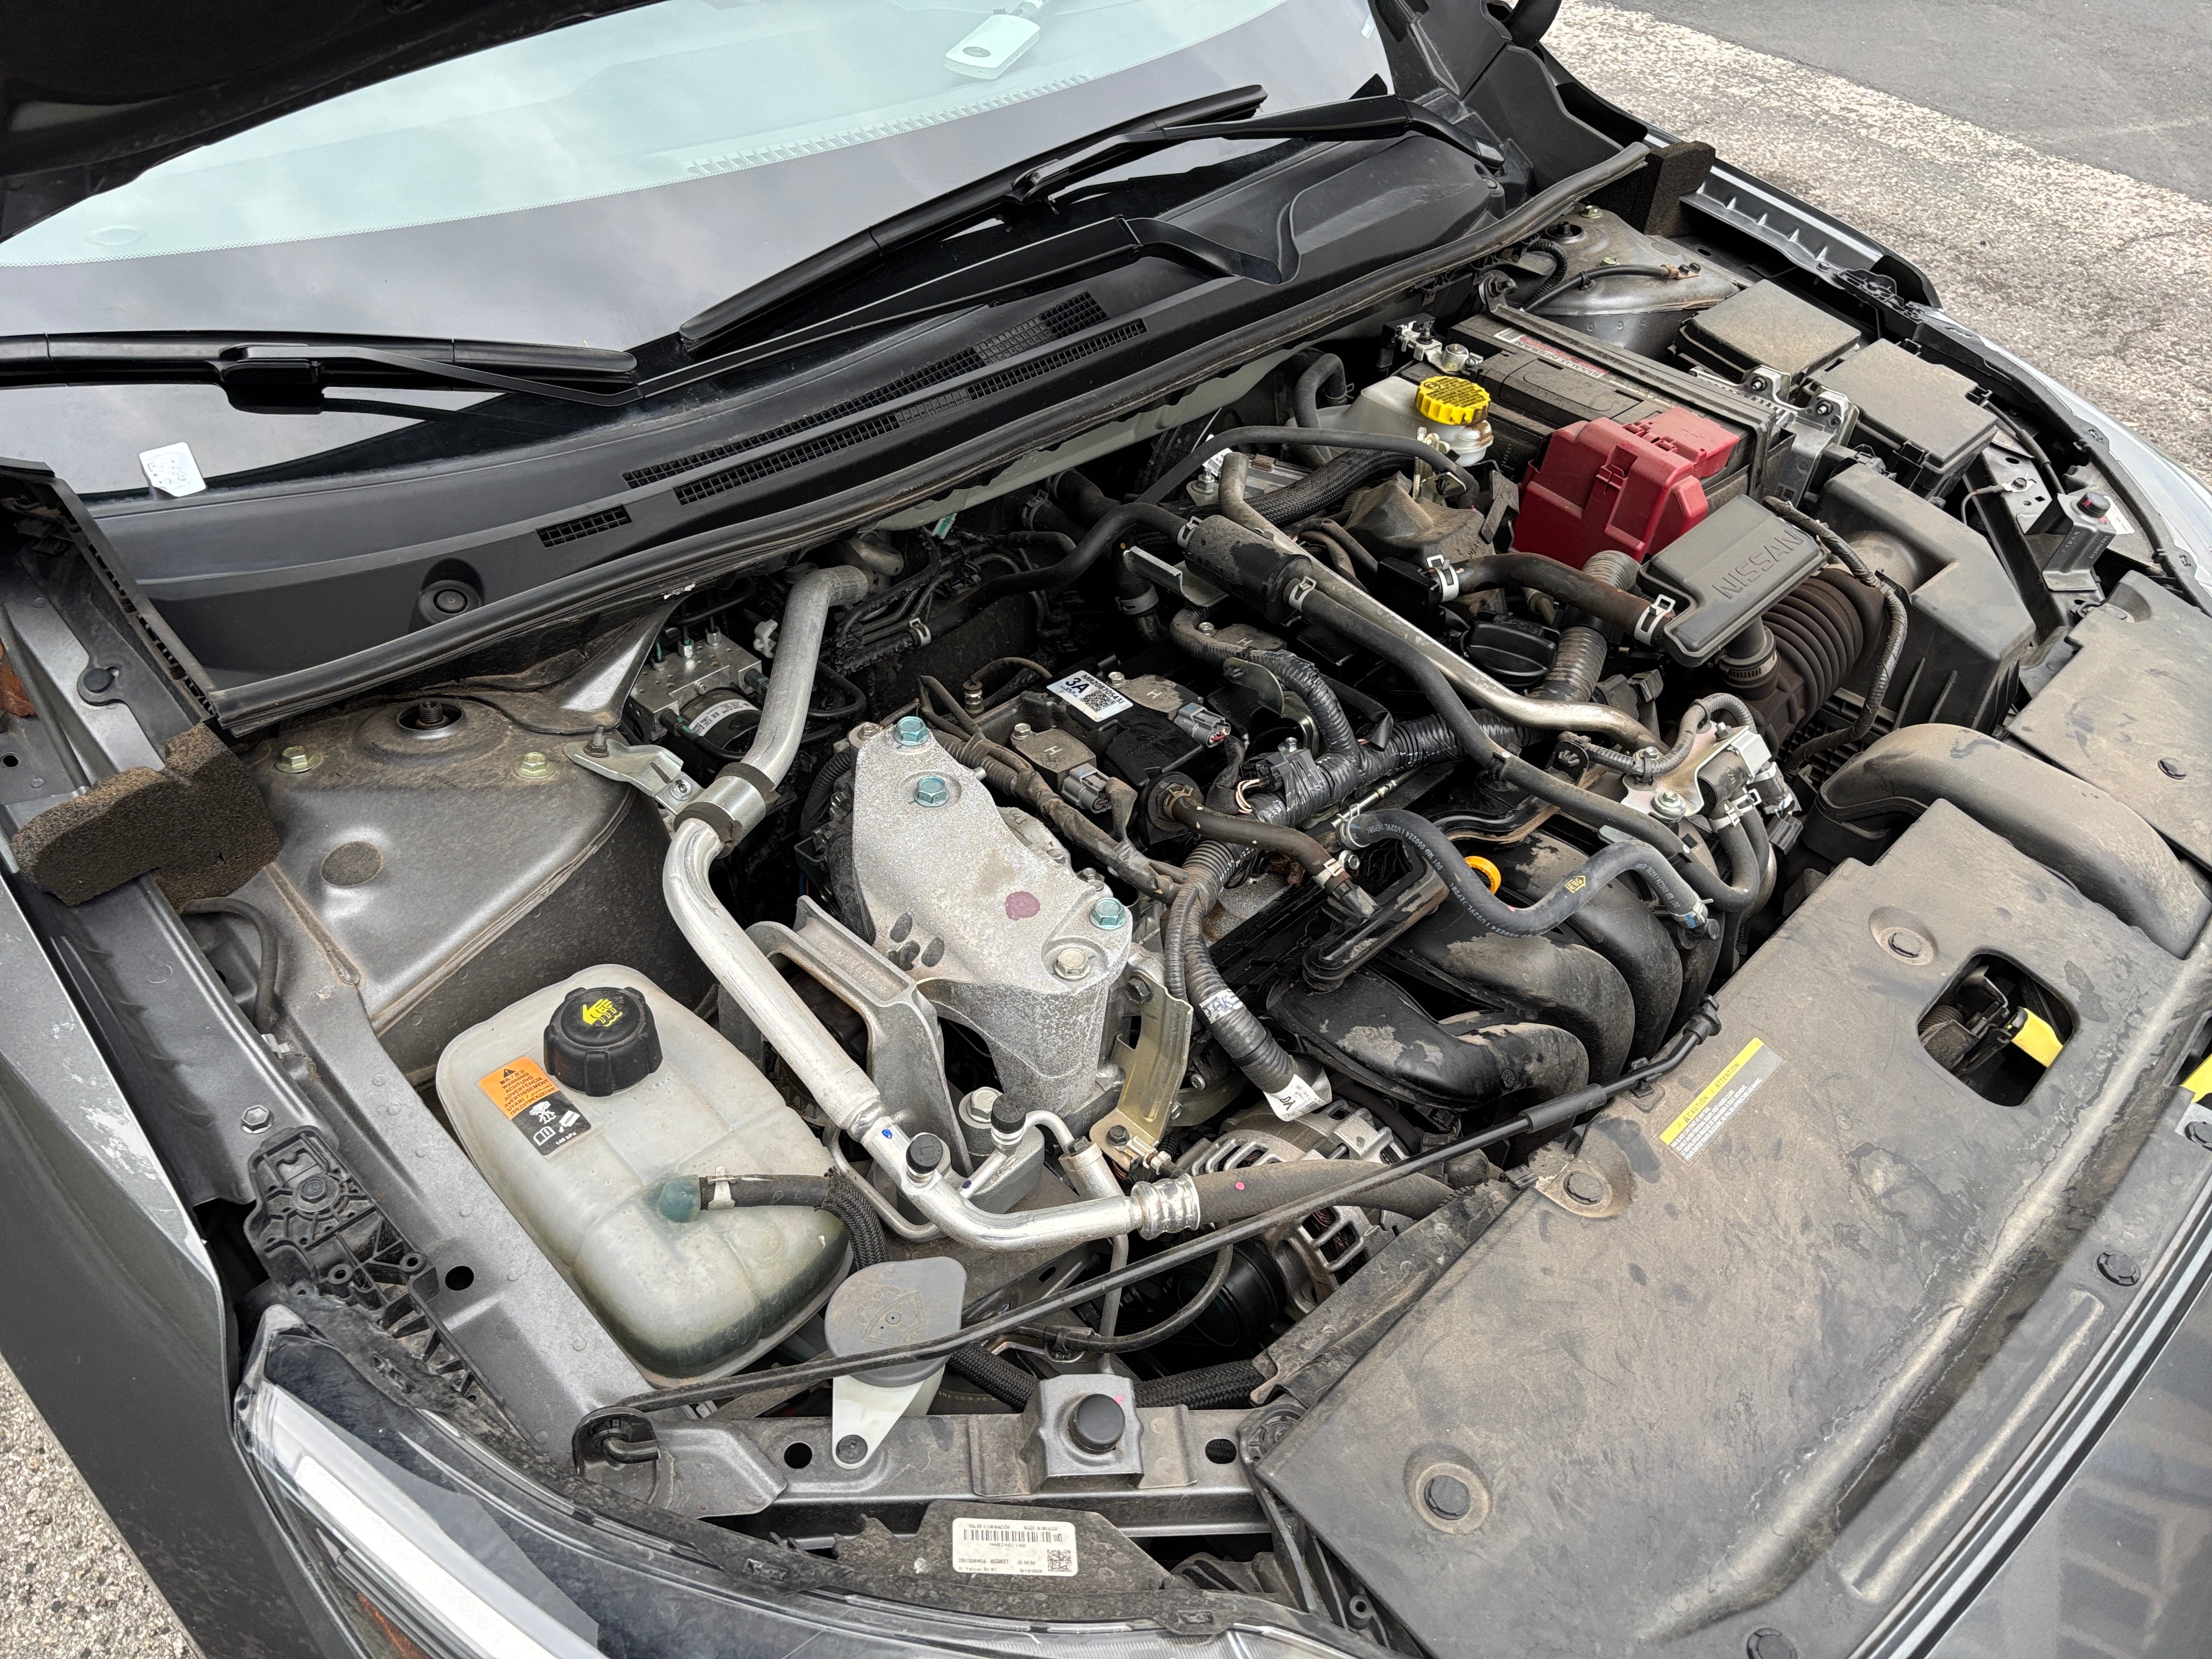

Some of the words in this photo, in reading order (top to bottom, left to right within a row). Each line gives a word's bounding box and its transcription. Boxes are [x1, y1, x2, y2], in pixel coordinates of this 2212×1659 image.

[1513, 340, 1558, 360] NISSAN
[1712, 529, 1805, 600] NISSAN
[1065, 677, 1090, 694] 3A
[1146, 689, 1164, 699] H
[1043, 745, 1063, 756] H
[500, 1071, 531, 1090] WARNING
[504, 1075, 534, 1093] ACHTUNG
[504, 1078, 549, 1108] AVERTISSEMENT
[1686, 1094, 1709, 1118] CAUTION
[1713, 1062, 1741, 1088] ATTENTION
[505, 1097, 526, 1111] UYARI
[564, 1130, 577, 1140] kPa
